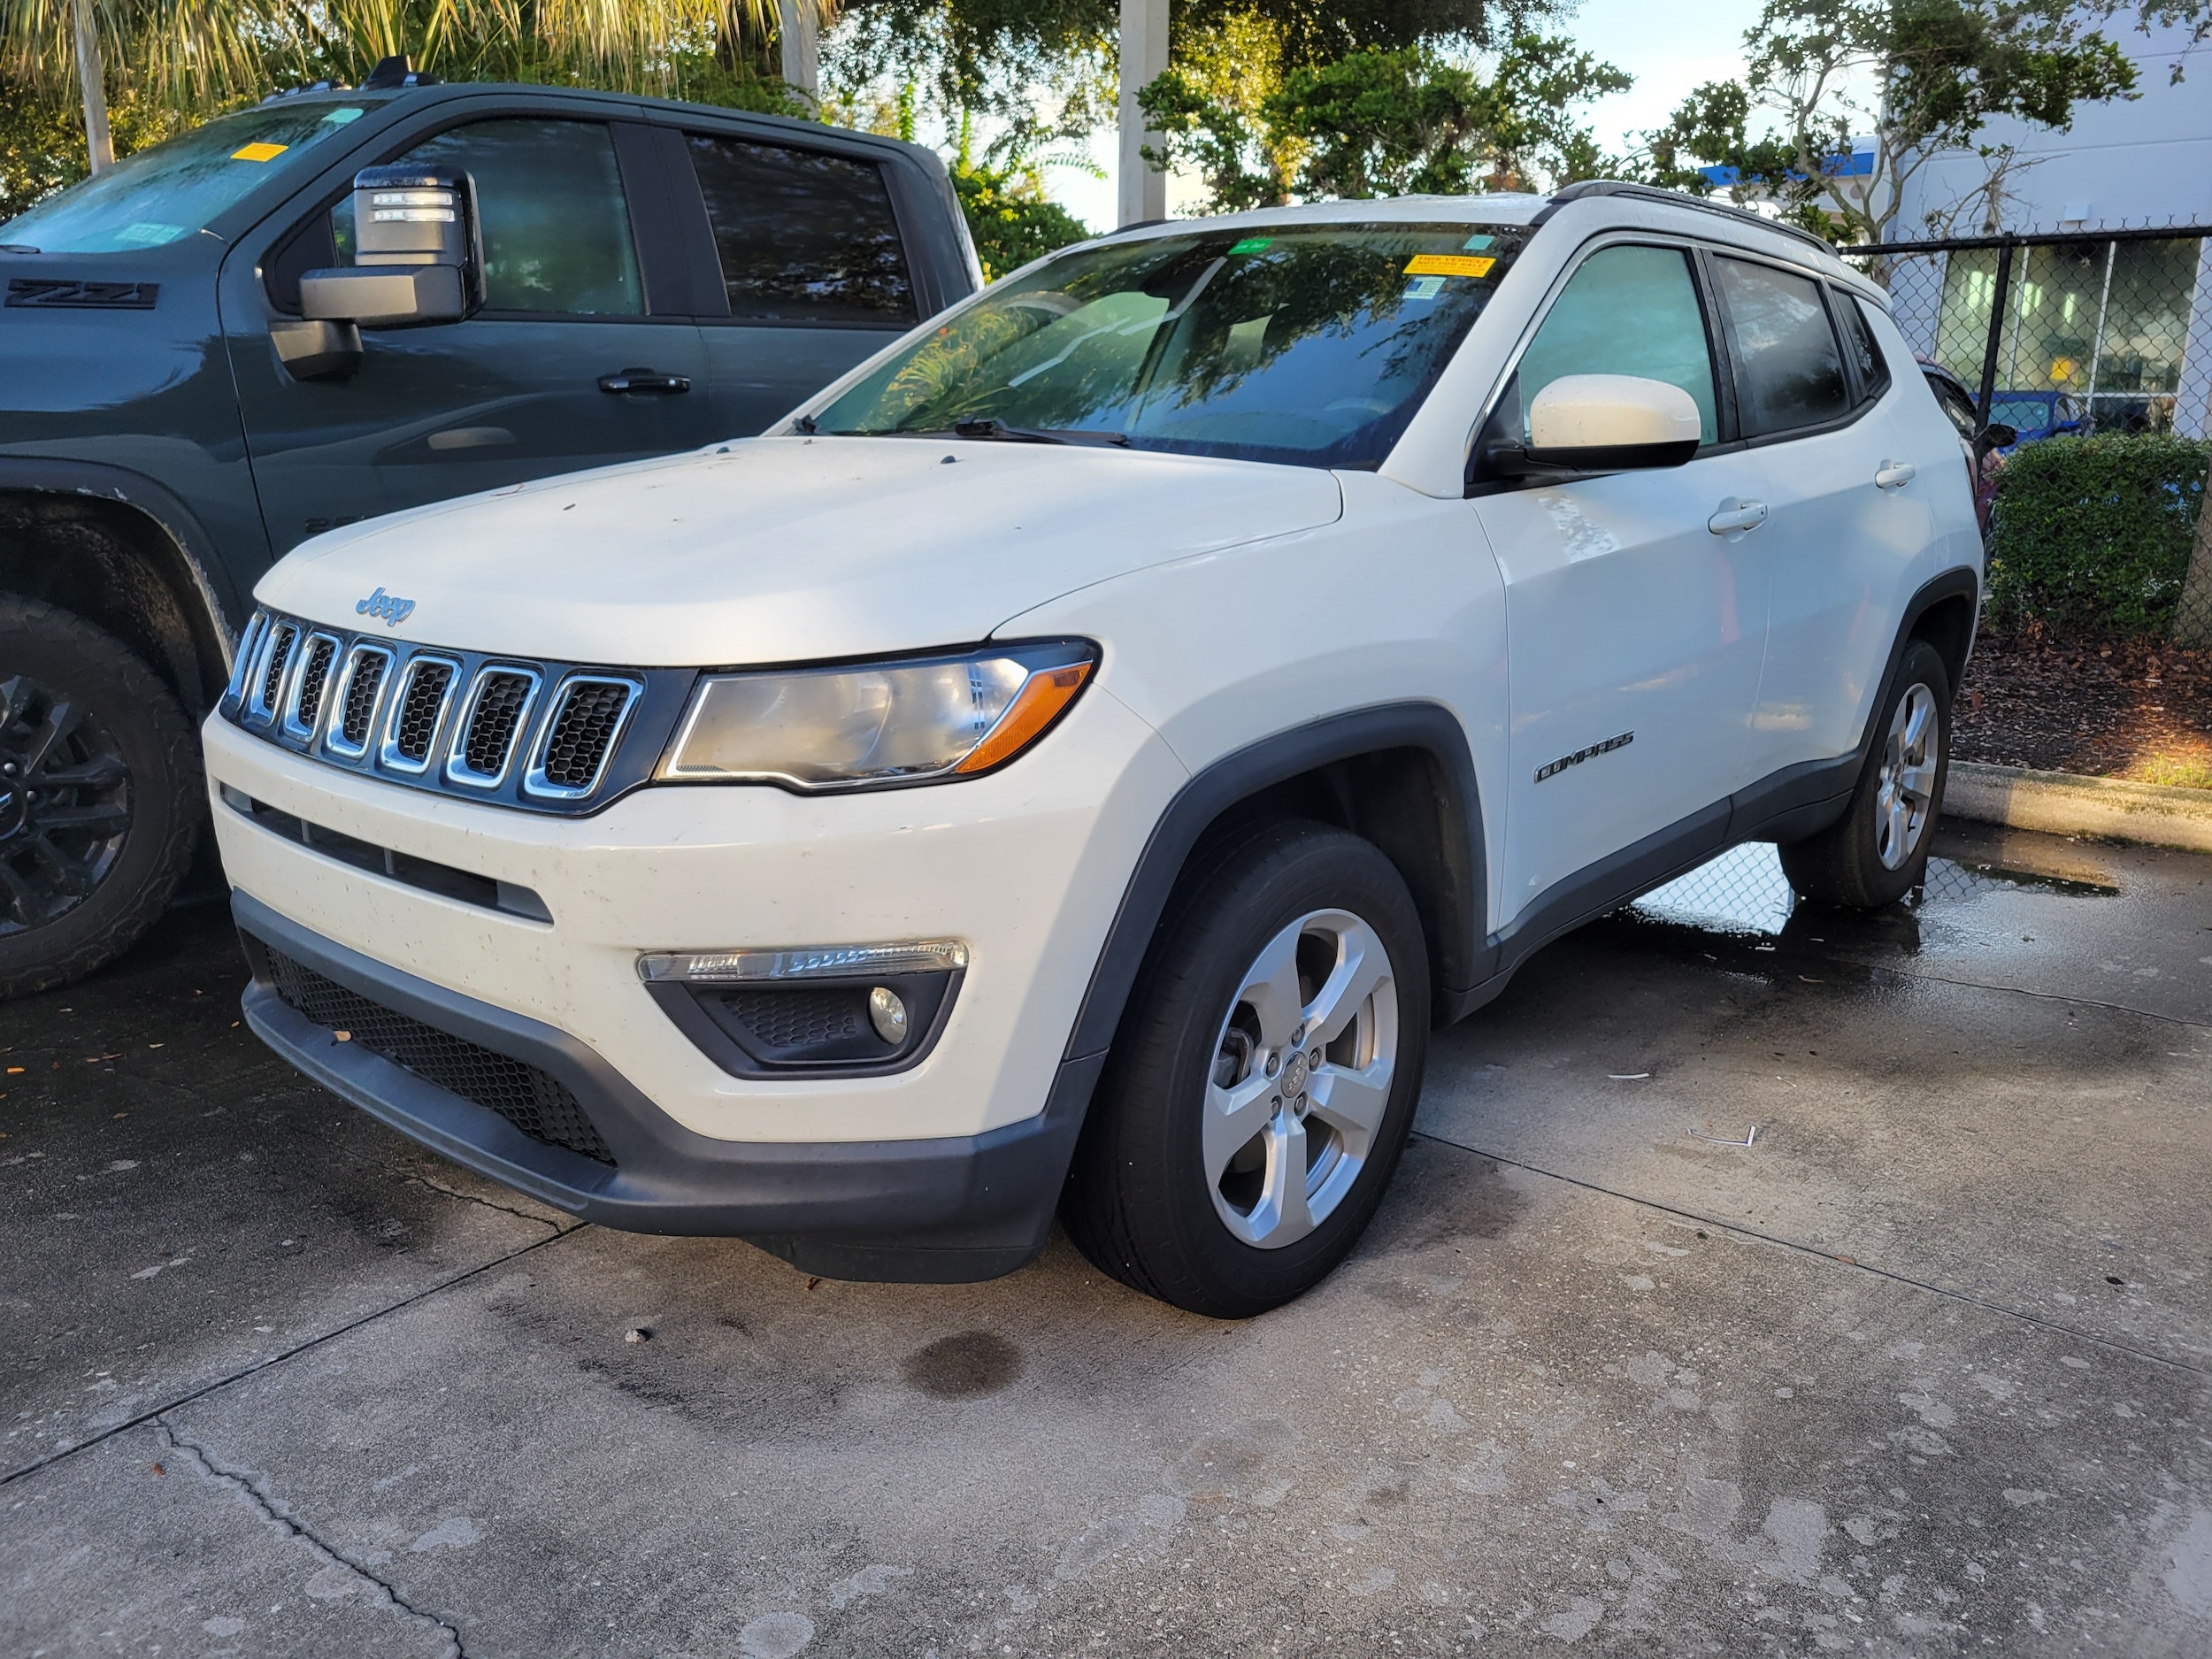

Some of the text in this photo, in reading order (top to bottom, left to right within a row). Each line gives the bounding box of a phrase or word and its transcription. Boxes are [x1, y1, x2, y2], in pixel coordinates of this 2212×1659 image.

[4, 278, 161, 310] Z71
[356, 587, 416, 627] Jeep
[1533, 728, 1635, 783] COMPASS
